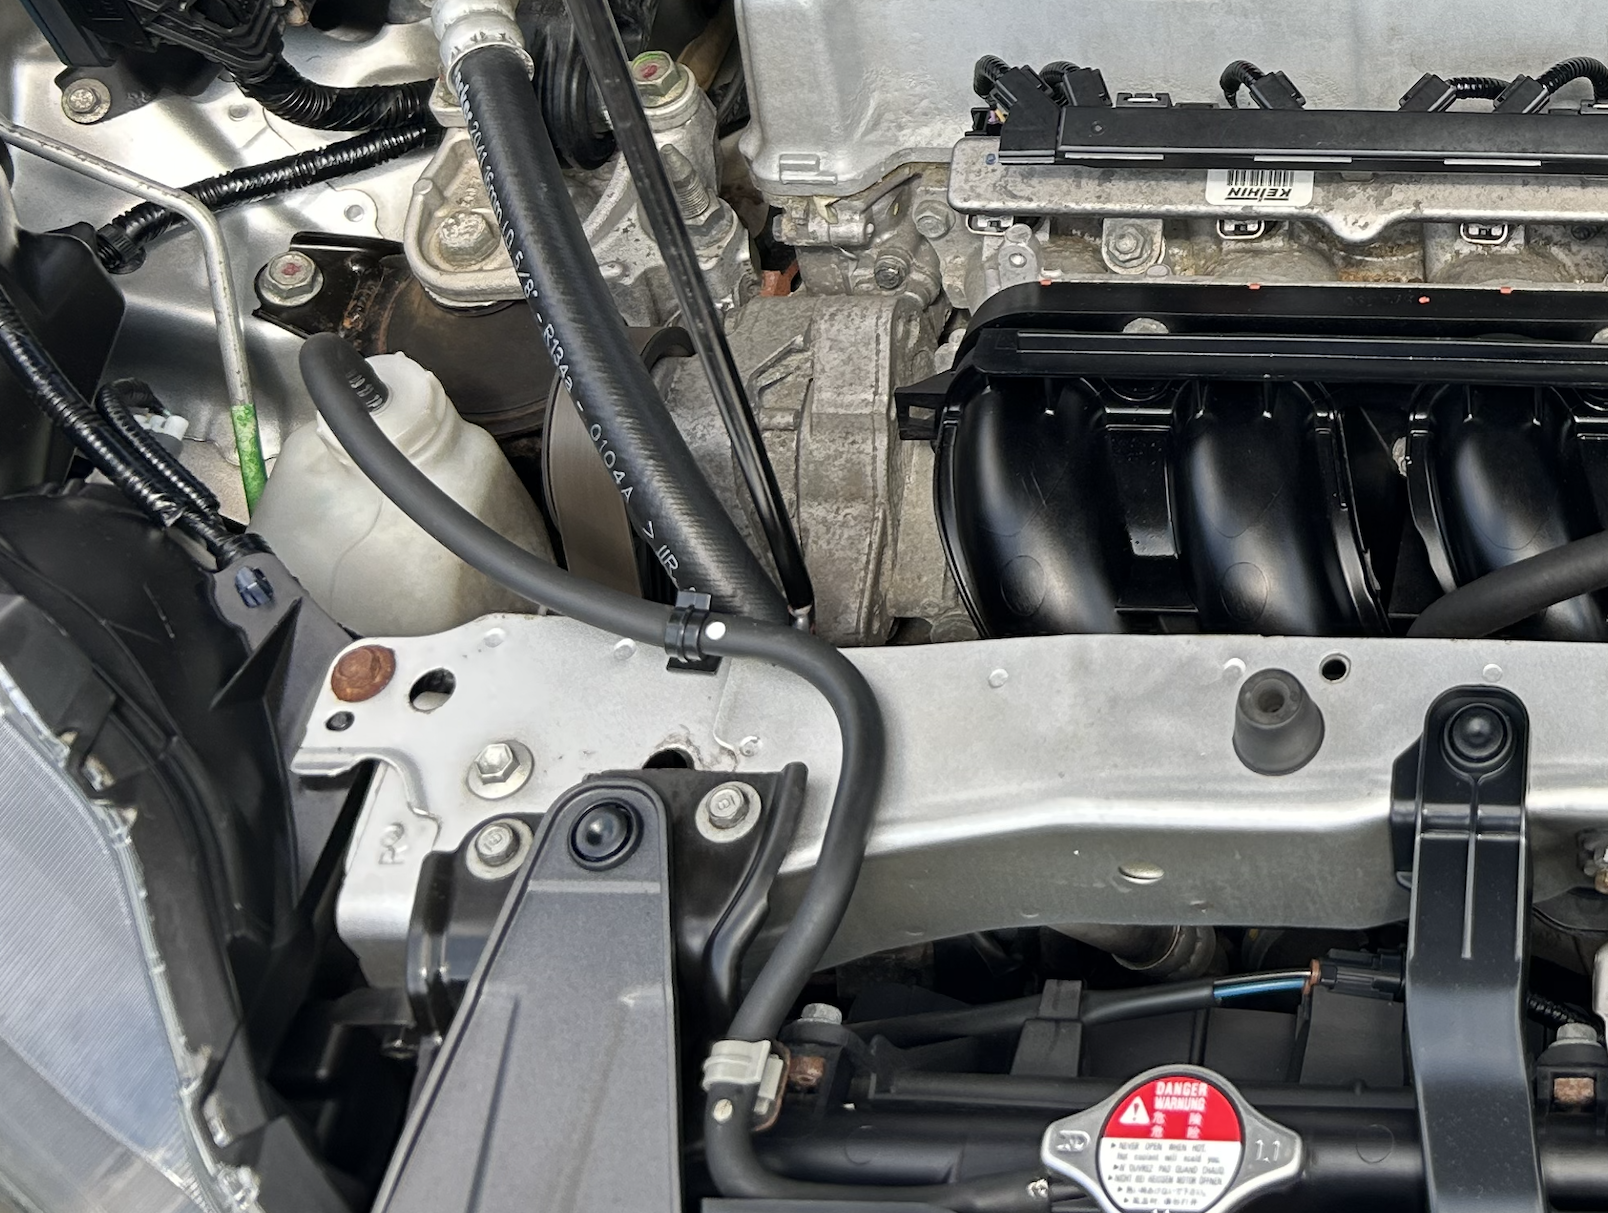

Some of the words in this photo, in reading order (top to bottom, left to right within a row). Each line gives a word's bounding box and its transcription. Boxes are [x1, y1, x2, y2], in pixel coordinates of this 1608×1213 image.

[1226, 187, 1292, 202] KEIHIN
[542, 323, 573, 393] R134a
[1155, 1081, 1208, 1097] DANGER
[1154, 1096, 1206, 1112] WARNUNG
[1145, 1142, 1163, 1151] OPEN
